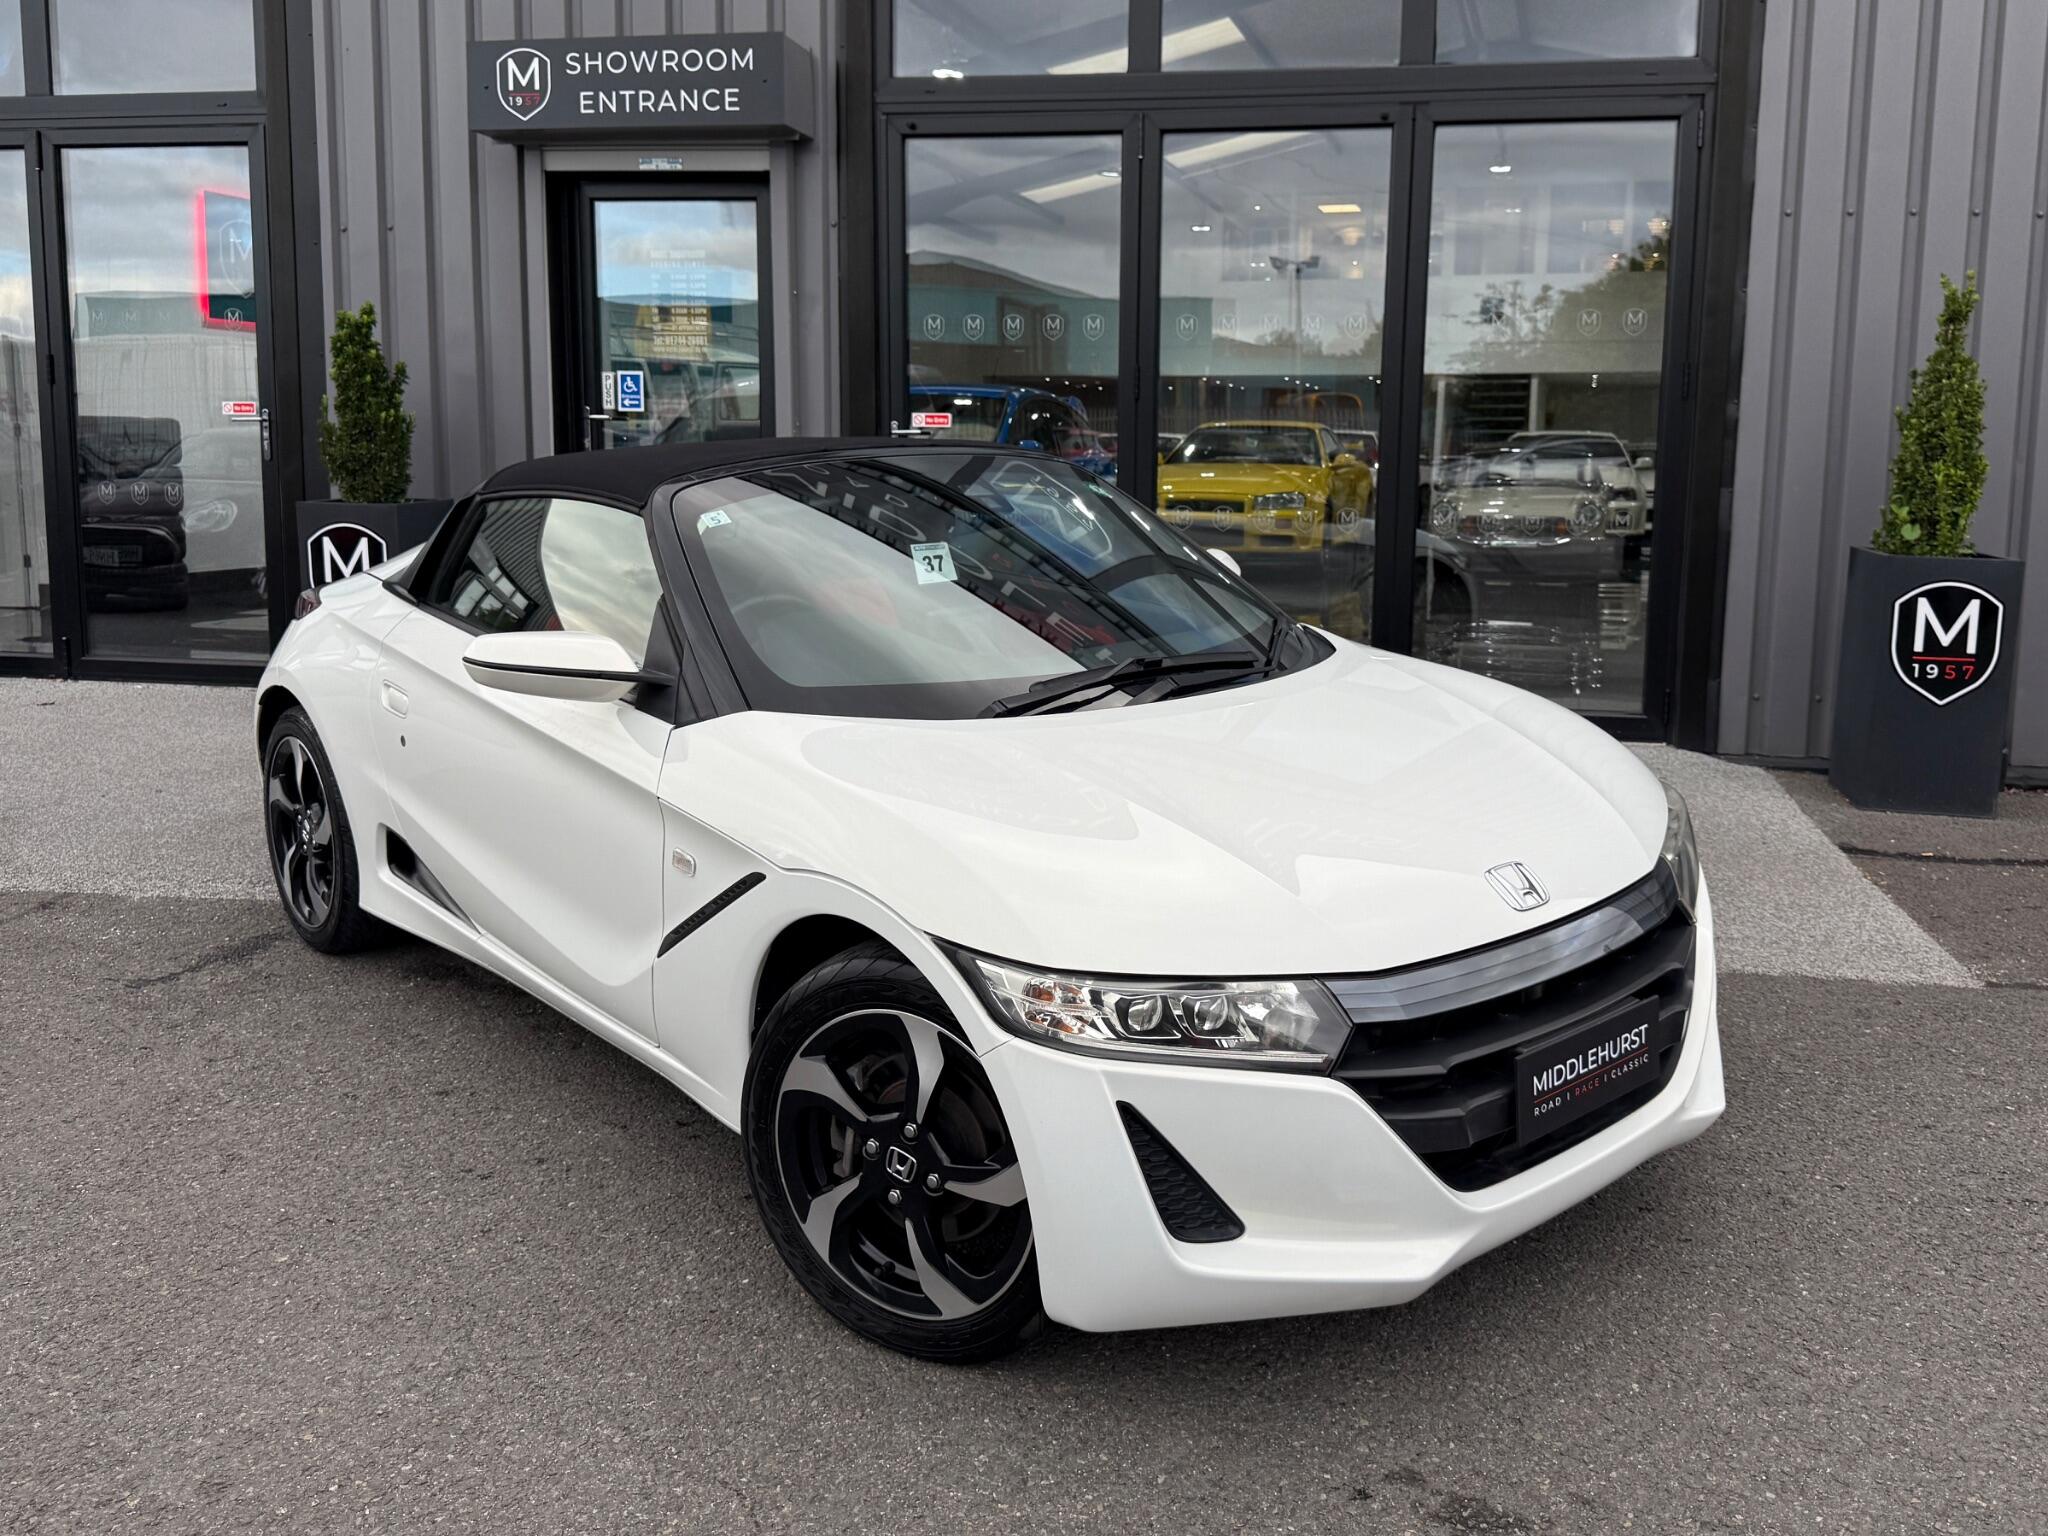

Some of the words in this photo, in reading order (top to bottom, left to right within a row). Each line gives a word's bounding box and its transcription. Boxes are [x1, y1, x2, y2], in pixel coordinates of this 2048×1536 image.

[507, 56, 540, 91] M
[565, 48, 753, 75] SHOWROOM
[508, 96, 542, 107] 1957
[579, 88, 740, 114] ENTRANCE
[605, 374, 613, 407] PUSH
[322, 536, 370, 583] M
[922, 554, 944, 573] 37
[1913, 597, 1981, 655] M
[1912, 663, 1975, 680] 1957
[1532, 1023, 1649, 1097] MIDDLEHURST
[1534, 1096, 1562, 1117] ROAD
[1575, 1079, 1600, 1097] RACE
[1611, 1053, 1649, 1079] CLASSIC
